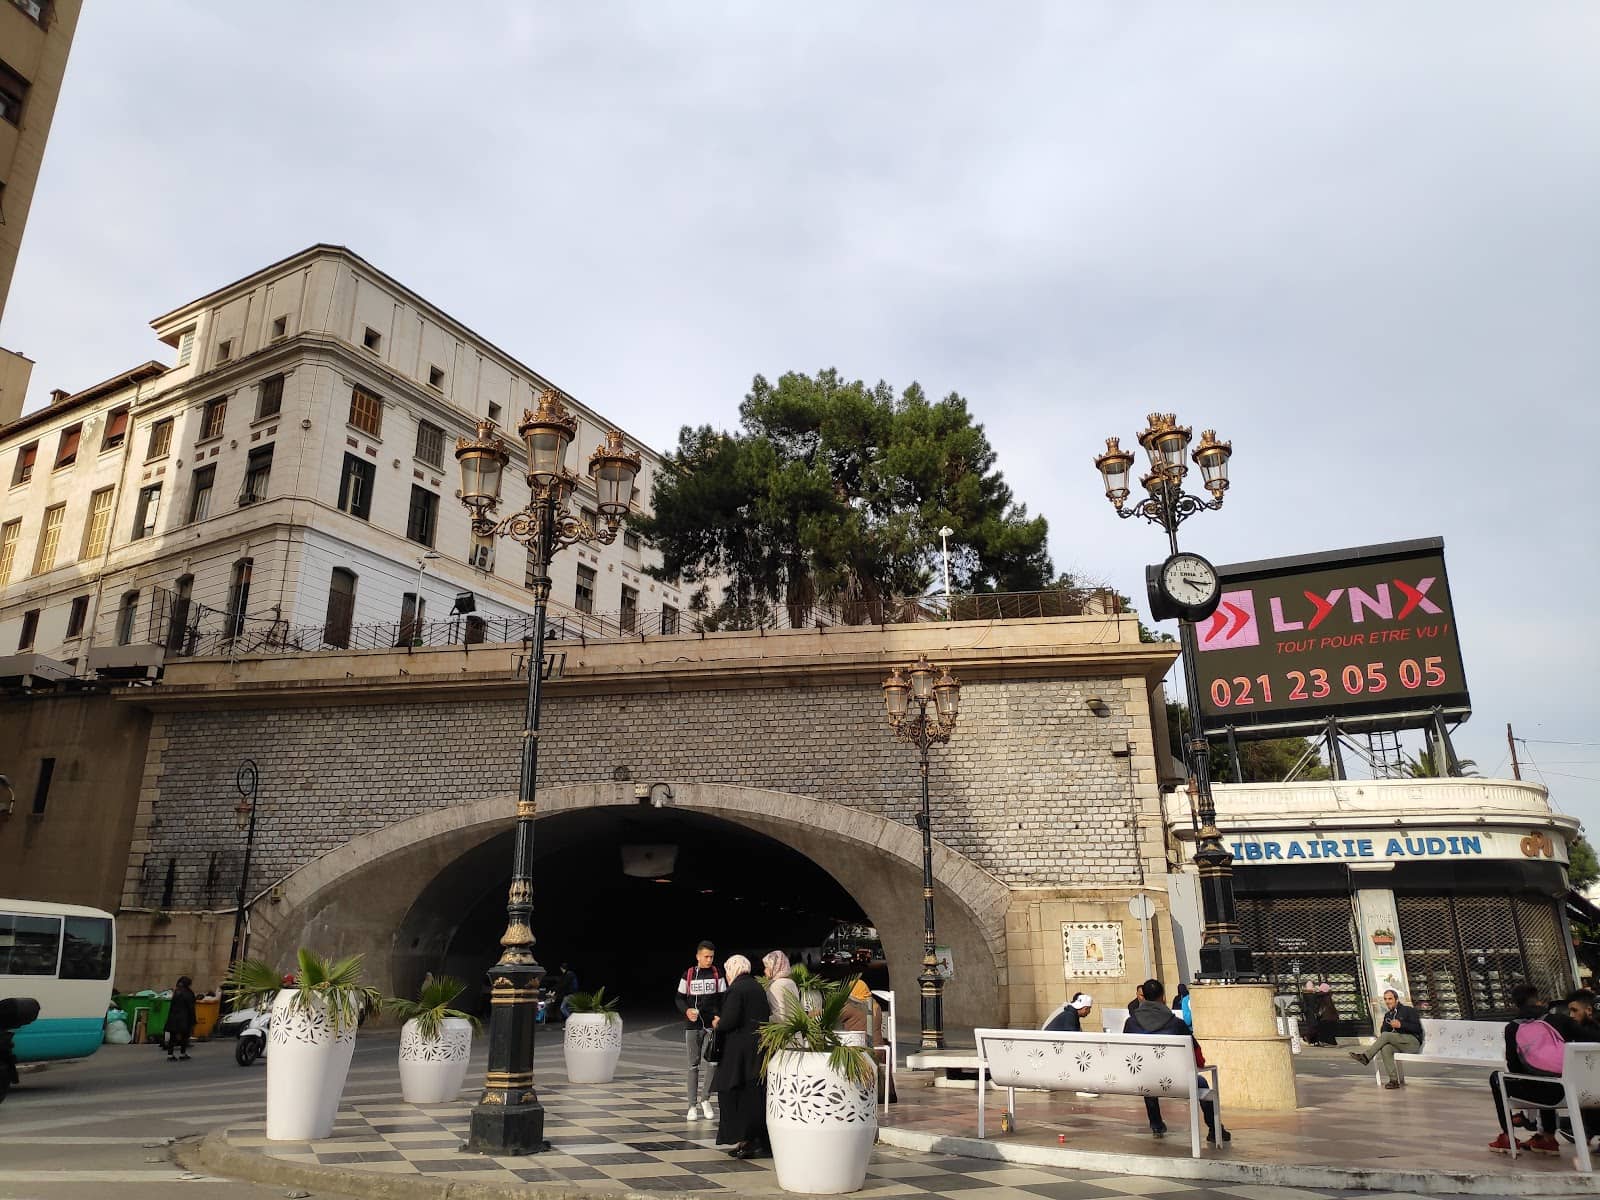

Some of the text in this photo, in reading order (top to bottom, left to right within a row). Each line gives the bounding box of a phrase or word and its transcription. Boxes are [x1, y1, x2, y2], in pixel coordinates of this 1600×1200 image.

[1269, 576, 1444, 632] LYNX
[1277, 638, 1317, 655] TOUT
[1320, 633, 1365, 649] POUR
[1369, 628, 1411, 644] ETRE
[1416, 625, 1438, 638] VU
[1210, 656, 1446, 707] 021 23 05 05
[1230, 836, 1482, 861] IBRAIRIE AUDIN
